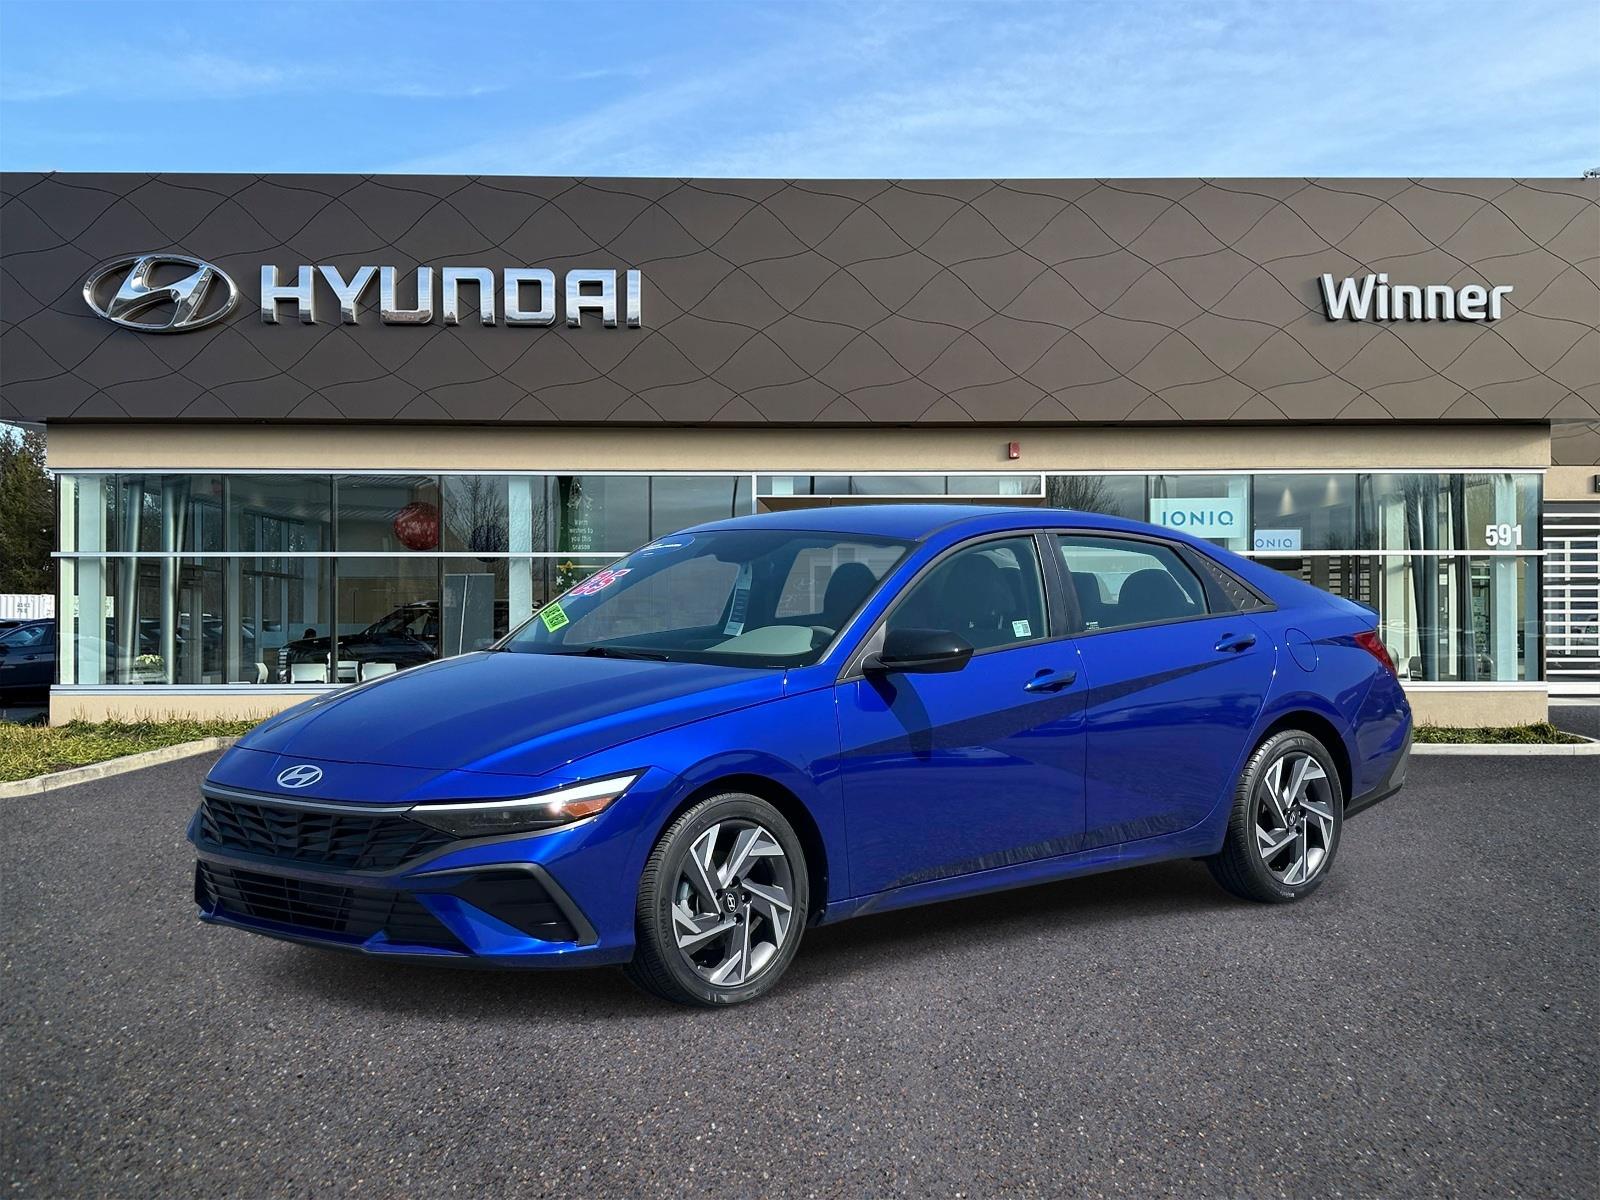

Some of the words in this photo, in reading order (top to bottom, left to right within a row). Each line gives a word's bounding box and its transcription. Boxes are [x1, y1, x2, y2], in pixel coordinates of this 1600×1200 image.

[260, 264, 642, 328] HYUNDAI
[1320, 273, 1514, 320] Winner
[1162, 511, 1234, 526] IONIQ
[1485, 523, 1522, 547] 591
[1255, 538, 1293, 548] ONIQ
[660, 897, 672, 949] KUMHO
